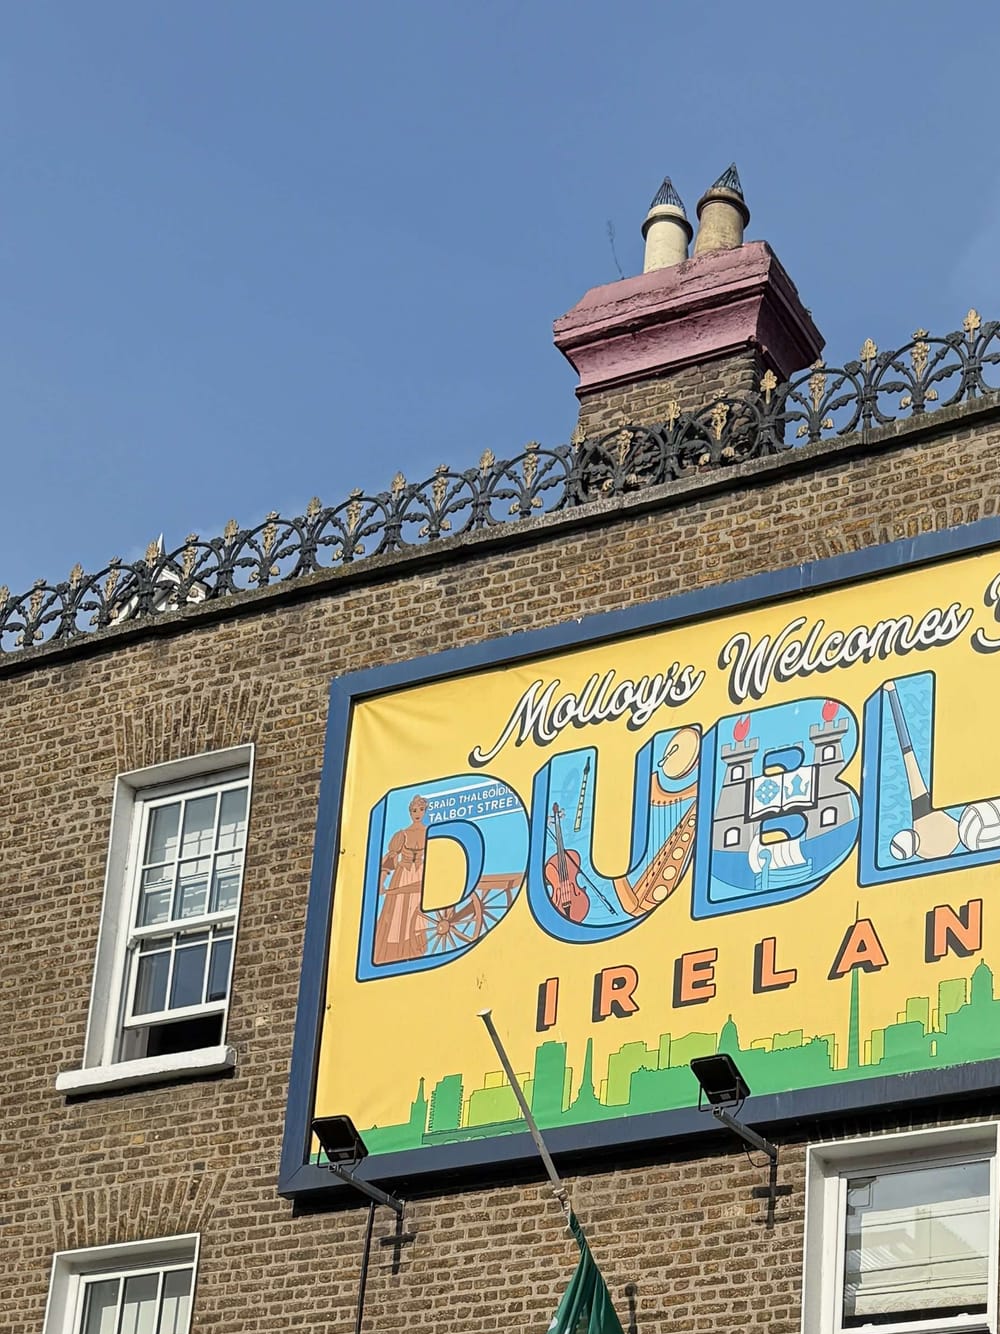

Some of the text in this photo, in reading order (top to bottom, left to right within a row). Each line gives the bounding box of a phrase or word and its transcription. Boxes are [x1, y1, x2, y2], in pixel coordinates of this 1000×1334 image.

[468, 660, 706, 768] Molloy's
[717, 614, 973, 704] Welcomes
[429, 796, 520, 823] TALBOT STREET
